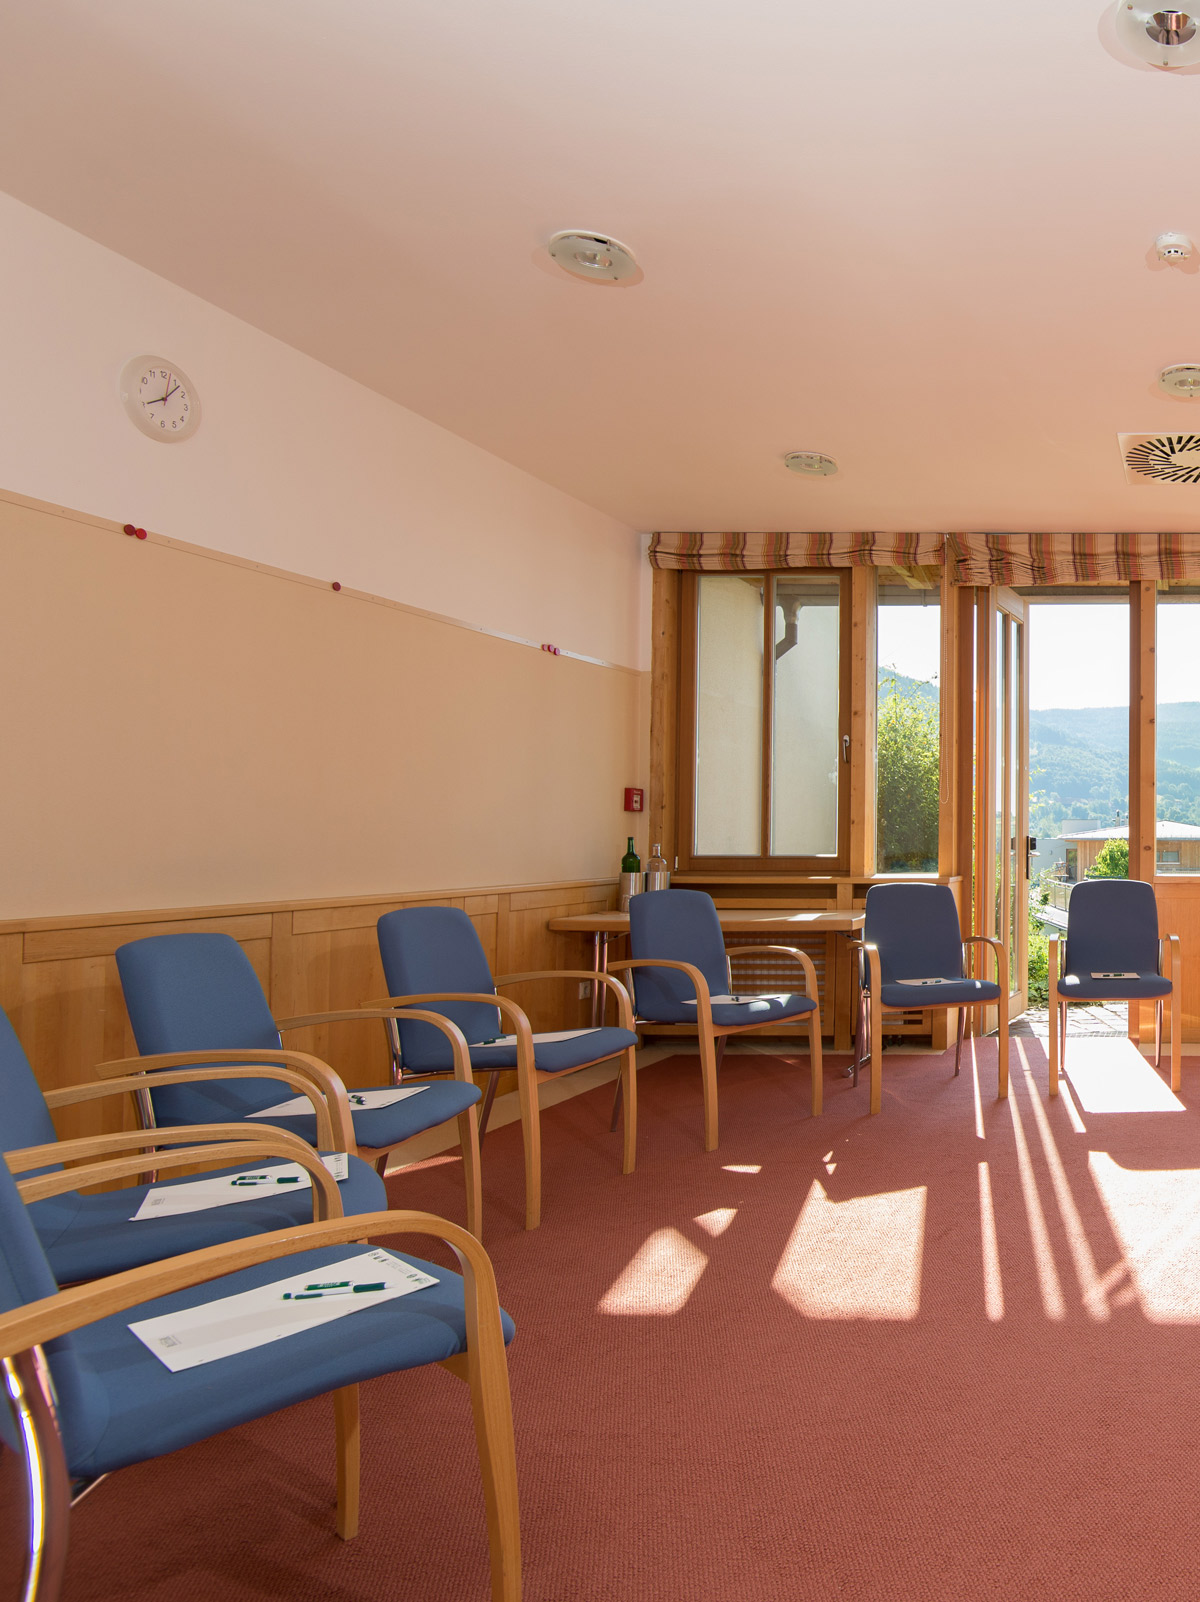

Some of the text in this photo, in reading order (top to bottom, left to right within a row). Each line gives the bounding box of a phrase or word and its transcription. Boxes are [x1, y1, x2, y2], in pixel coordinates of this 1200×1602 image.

[149, 370, 156, 378] 11
[160, 370, 167, 379] 12
[181, 391, 186, 399] 2
[184, 403, 189, 411] 3
[160, 420, 166, 428] 6
[172, 420, 177, 429] 5
